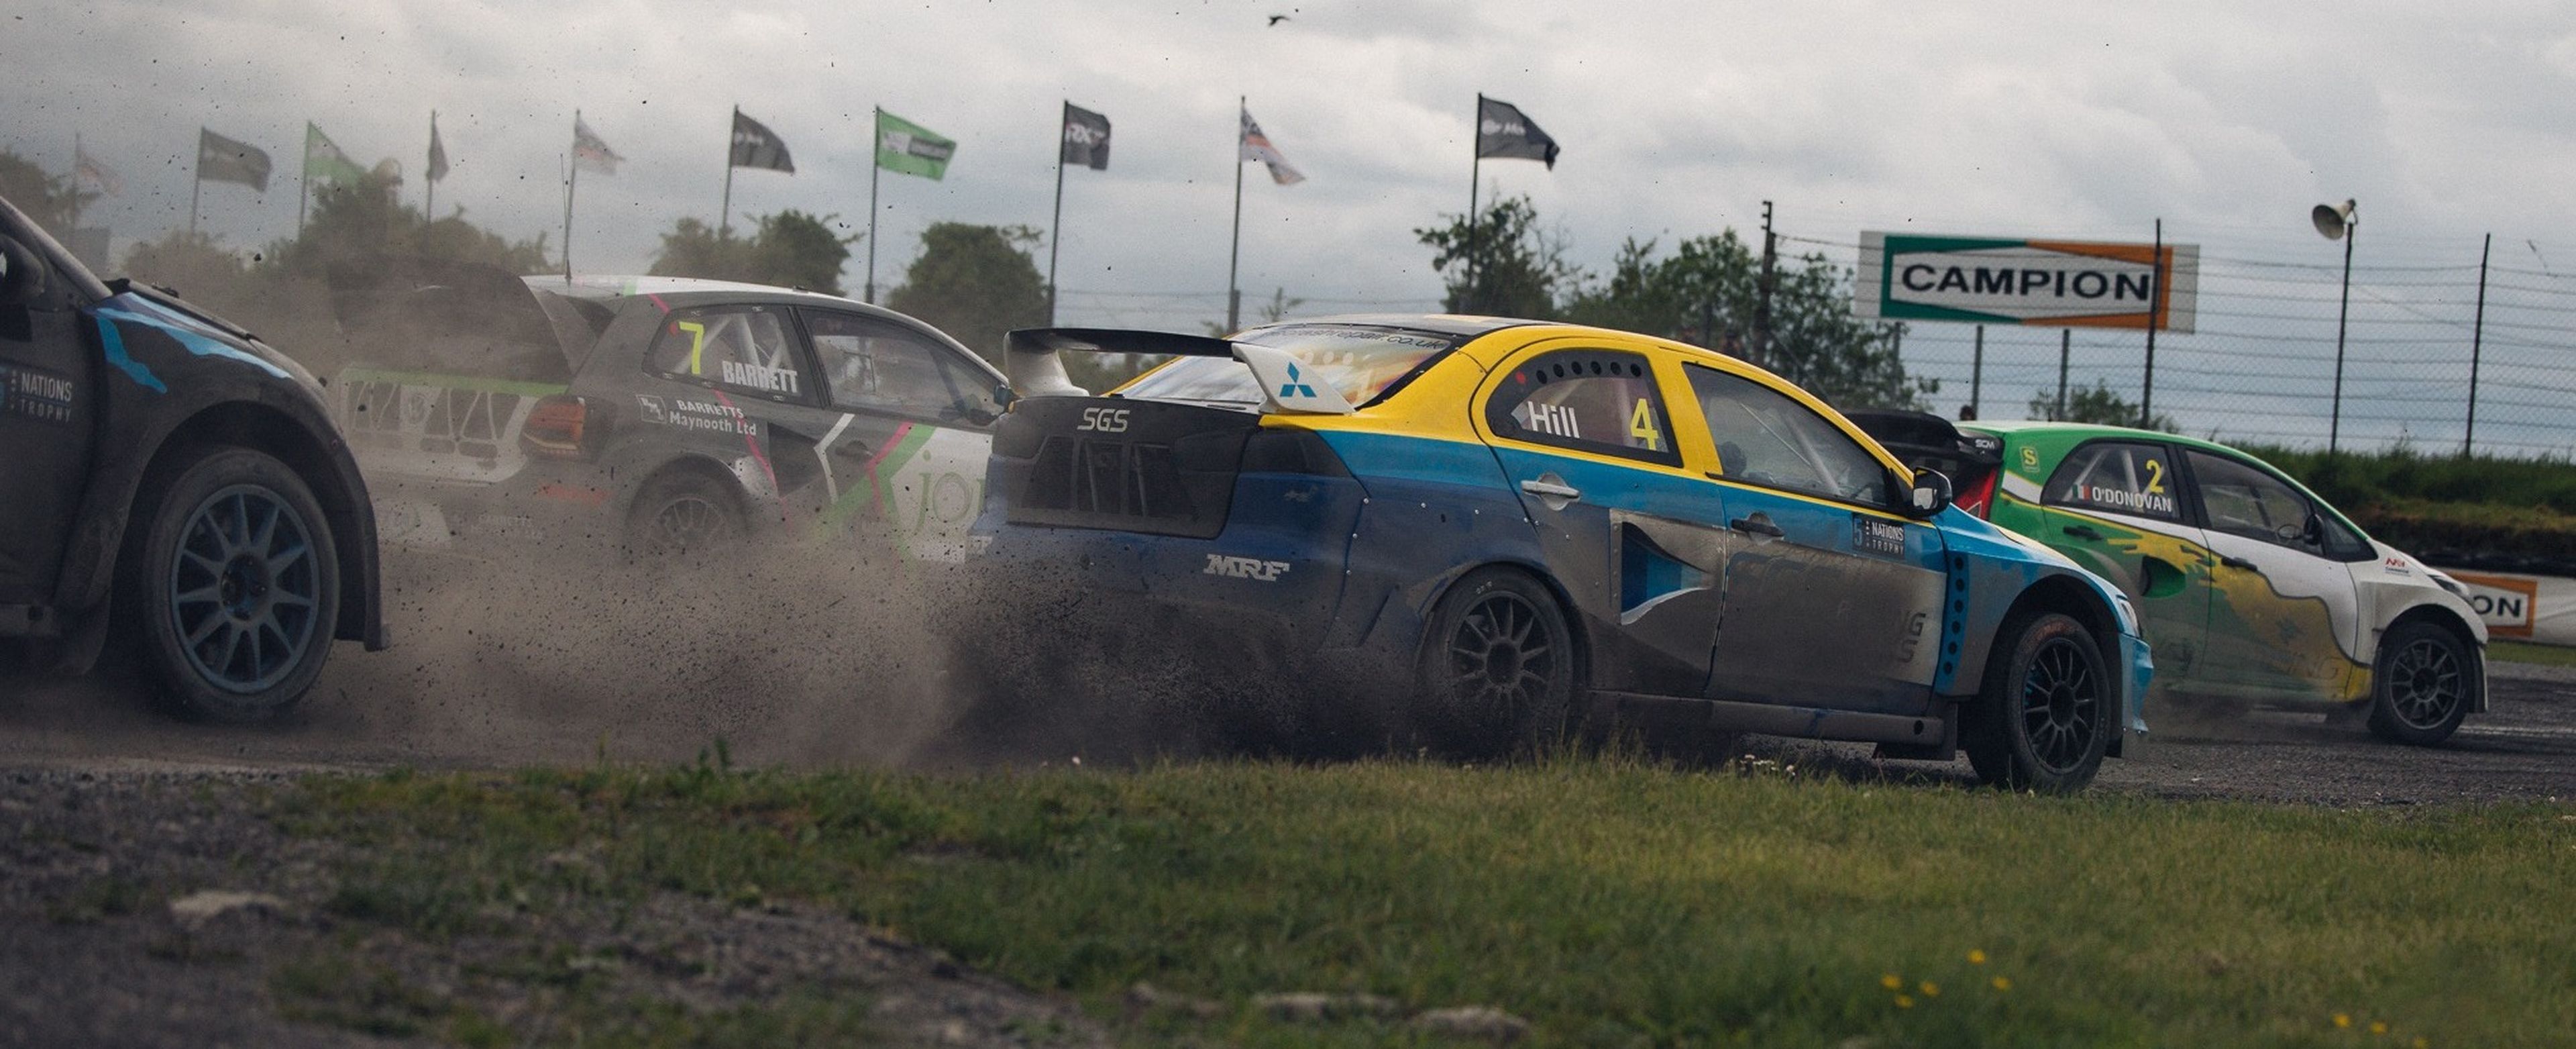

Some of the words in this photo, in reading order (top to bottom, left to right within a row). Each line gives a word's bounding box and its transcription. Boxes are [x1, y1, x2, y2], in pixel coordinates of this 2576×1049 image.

[1901, 264, 2149, 300] CAMPION
[679, 321, 704, 375] 7
[21, 372, 72, 401] NATIONS
[722, 360, 798, 393] BARRETT
[21, 399, 71, 423] TROPHY
[676, 400, 745, 419] BARRETTS
[1077, 407, 1130, 432] SGS
[1527, 401, 1580, 438] Hill
[670, 411, 733, 432] Maynooth
[737, 420, 757, 436] Ltd
[1630, 399, 1659, 451] 4
[2145, 458, 2165, 493] 2
[2092, 487, 2172, 513] O'DONOVAN
[1872, 521, 1904, 542] NATIONS
[1872, 539, 1904, 555] TROPHY
[1203, 554, 1290, 581] MRF
